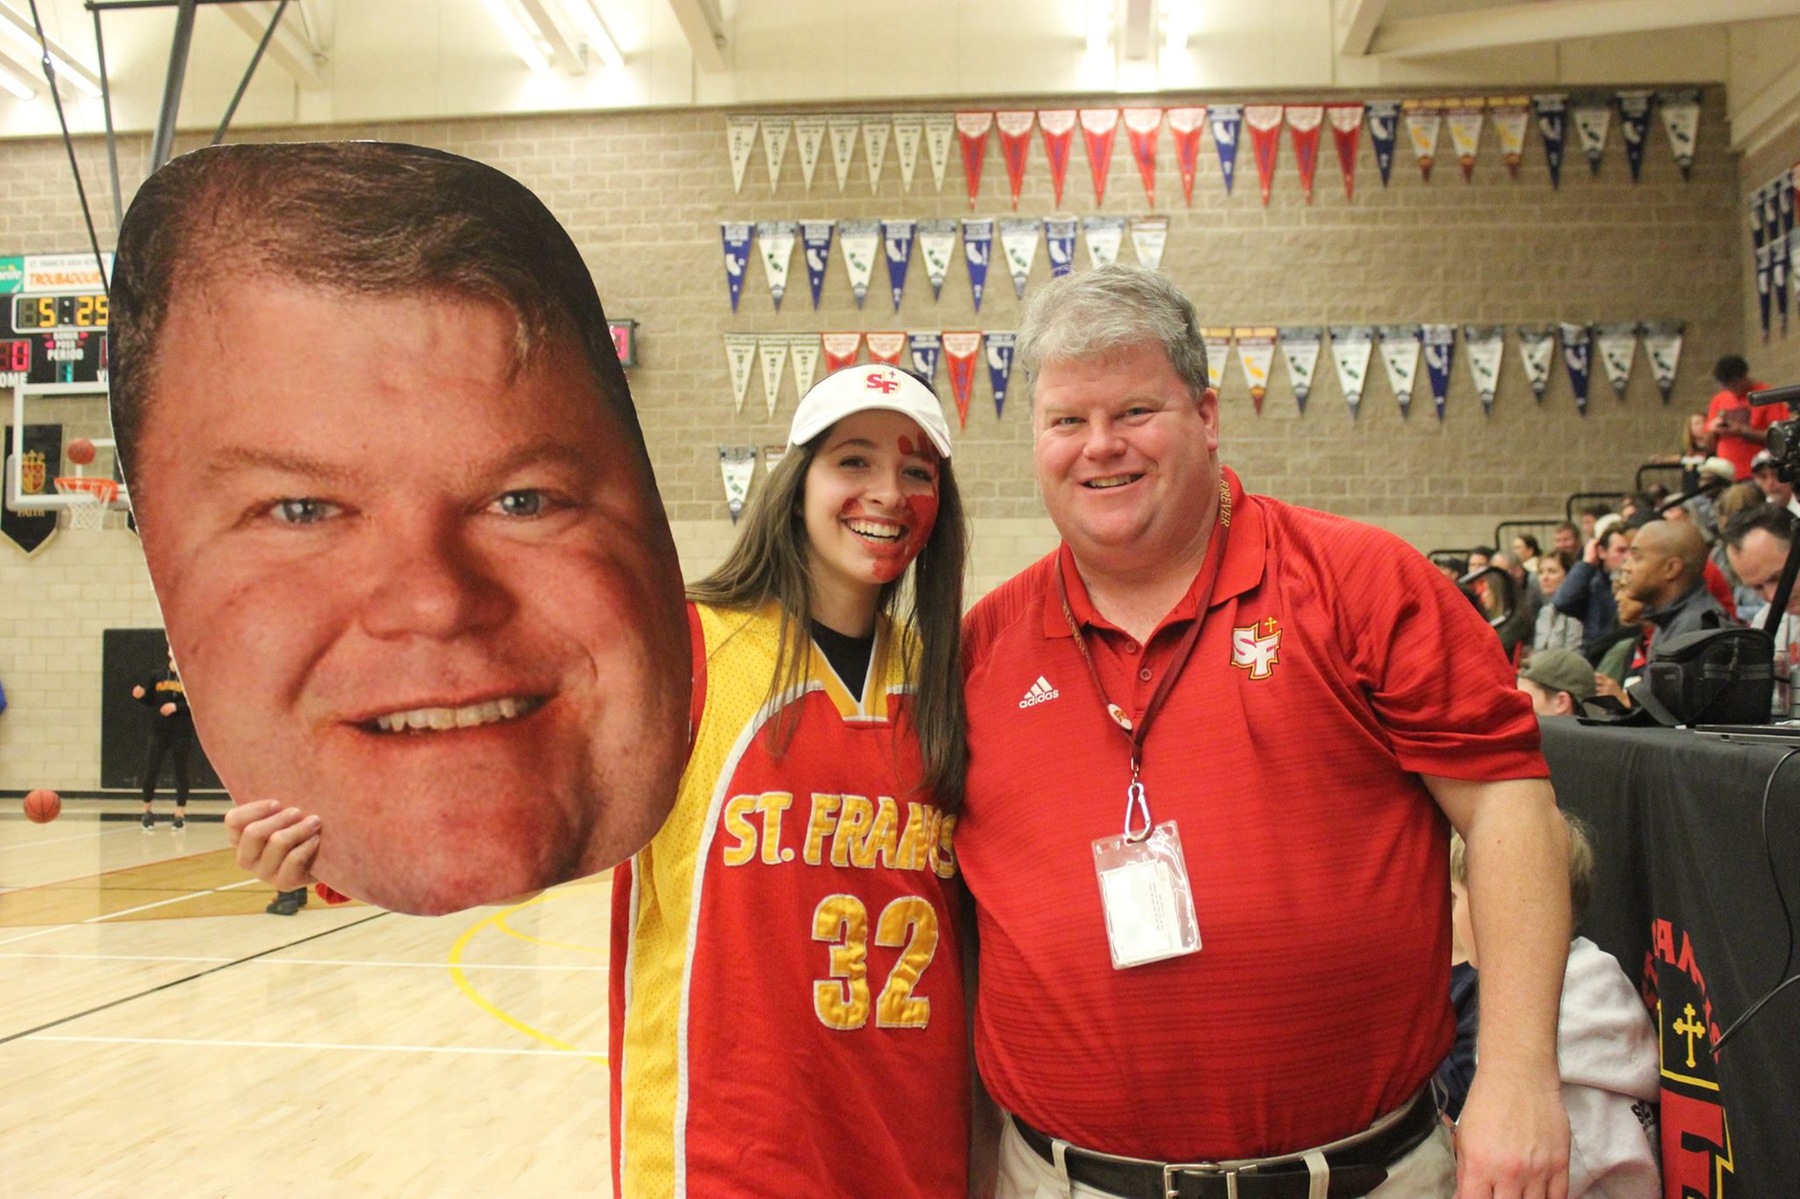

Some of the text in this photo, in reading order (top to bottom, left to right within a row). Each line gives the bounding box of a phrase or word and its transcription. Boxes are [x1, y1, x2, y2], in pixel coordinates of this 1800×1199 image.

[30, 271, 102, 286] TROUBADOUR
[47, 348, 84, 361] PERIOD
[0, 371, 29, 388] OME
[867, 373, 898, 394] SF
[1219, 479, 1232, 527] FOREVER
[1231, 623, 1282, 679] SF
[1019, 689, 1059, 709] adidas
[723, 791, 795, 866] ST.
[811, 893, 939, 1030] 32
